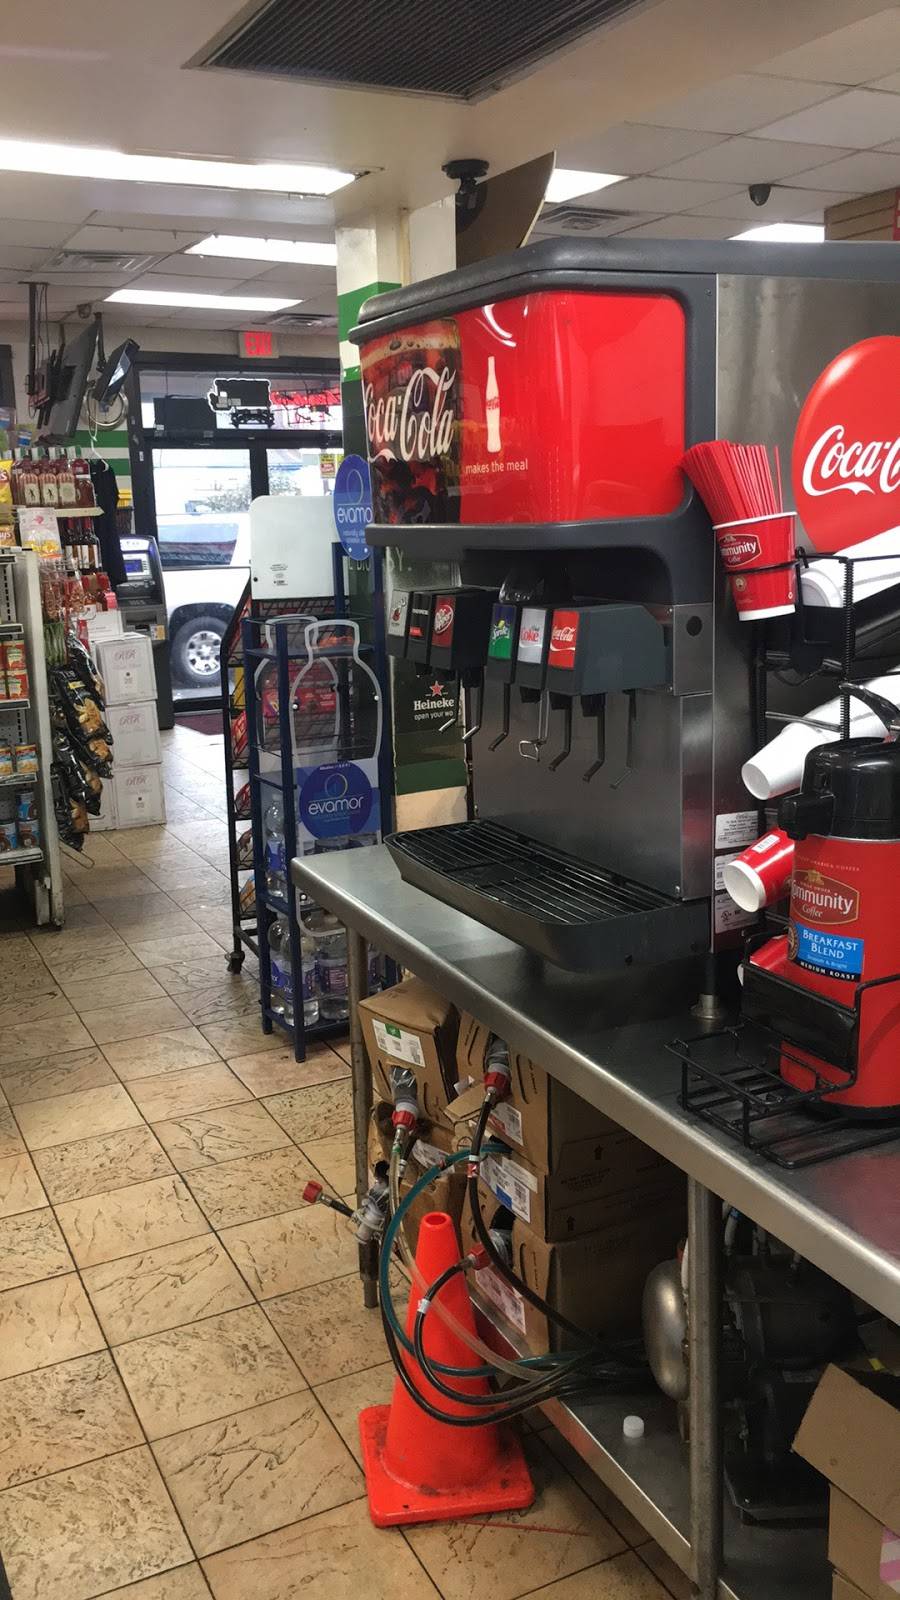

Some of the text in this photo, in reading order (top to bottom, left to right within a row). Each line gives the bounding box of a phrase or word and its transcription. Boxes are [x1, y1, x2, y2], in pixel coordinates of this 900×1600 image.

[465, 459, 528, 476] makes the meal
[414, 713, 430, 721] open
[430, 711, 443, 720] your
[308, 796, 364, 815] evamor
[802, 929, 859, 951] BREAKFAST
[811, 942, 845, 959] BLEND
[800, 961, 855, 981] MEDIUM ROAST
